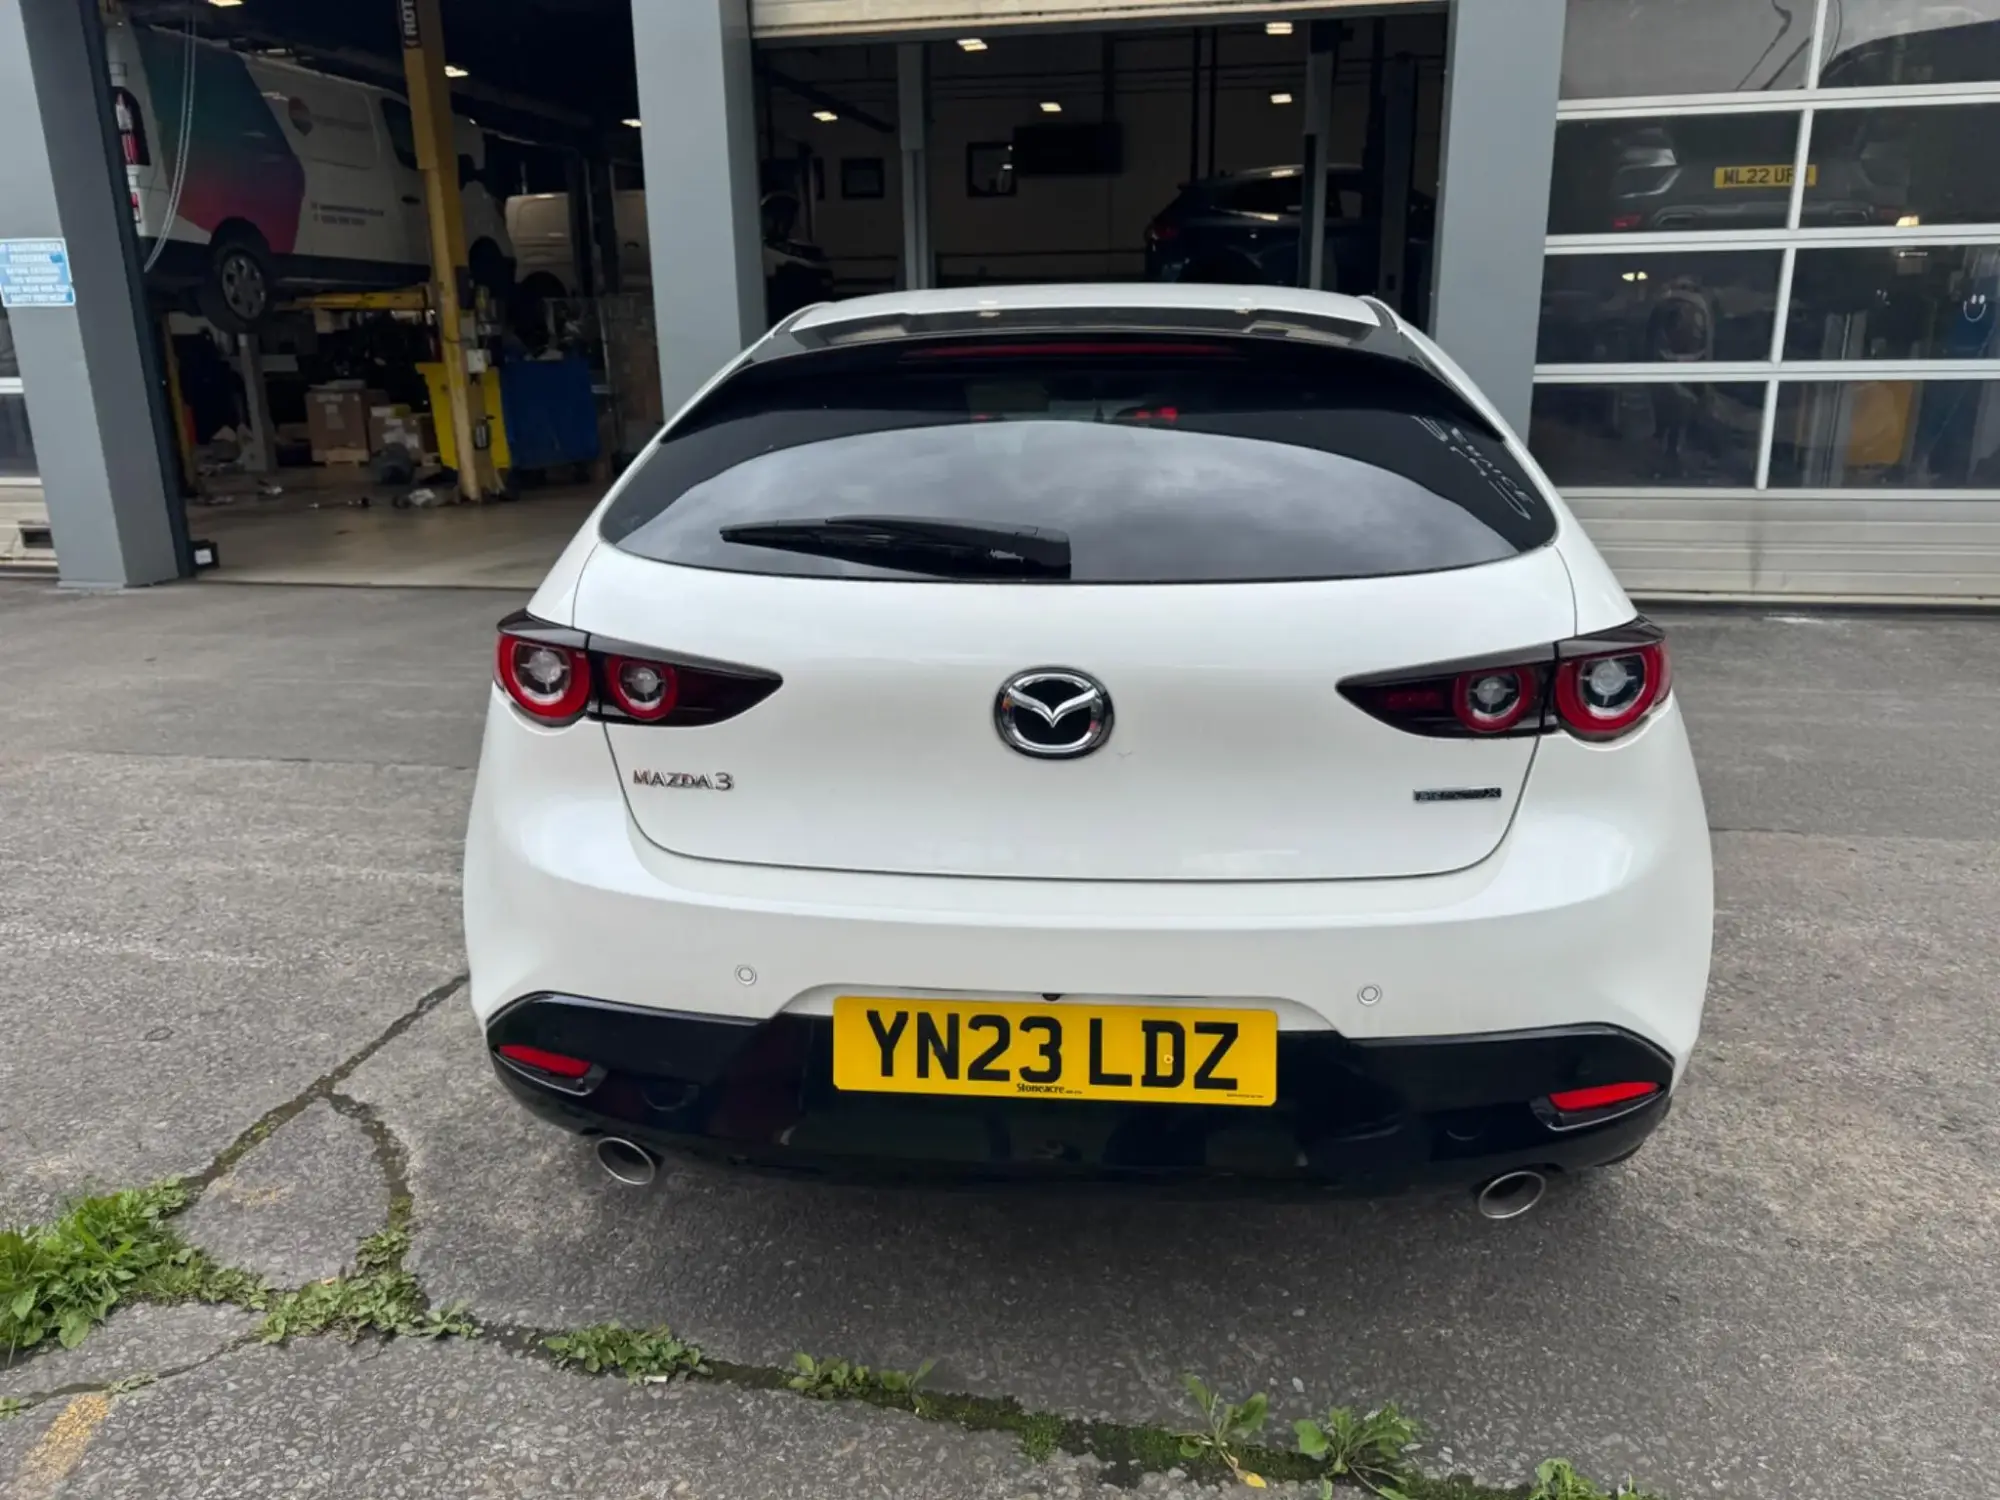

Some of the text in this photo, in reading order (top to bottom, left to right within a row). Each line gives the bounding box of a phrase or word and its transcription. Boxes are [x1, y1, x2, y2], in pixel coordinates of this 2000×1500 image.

[866, 1009, 1239, 1090] YN23 LDZ
[1016, 1083, 1065, 1094] Stoneacre
